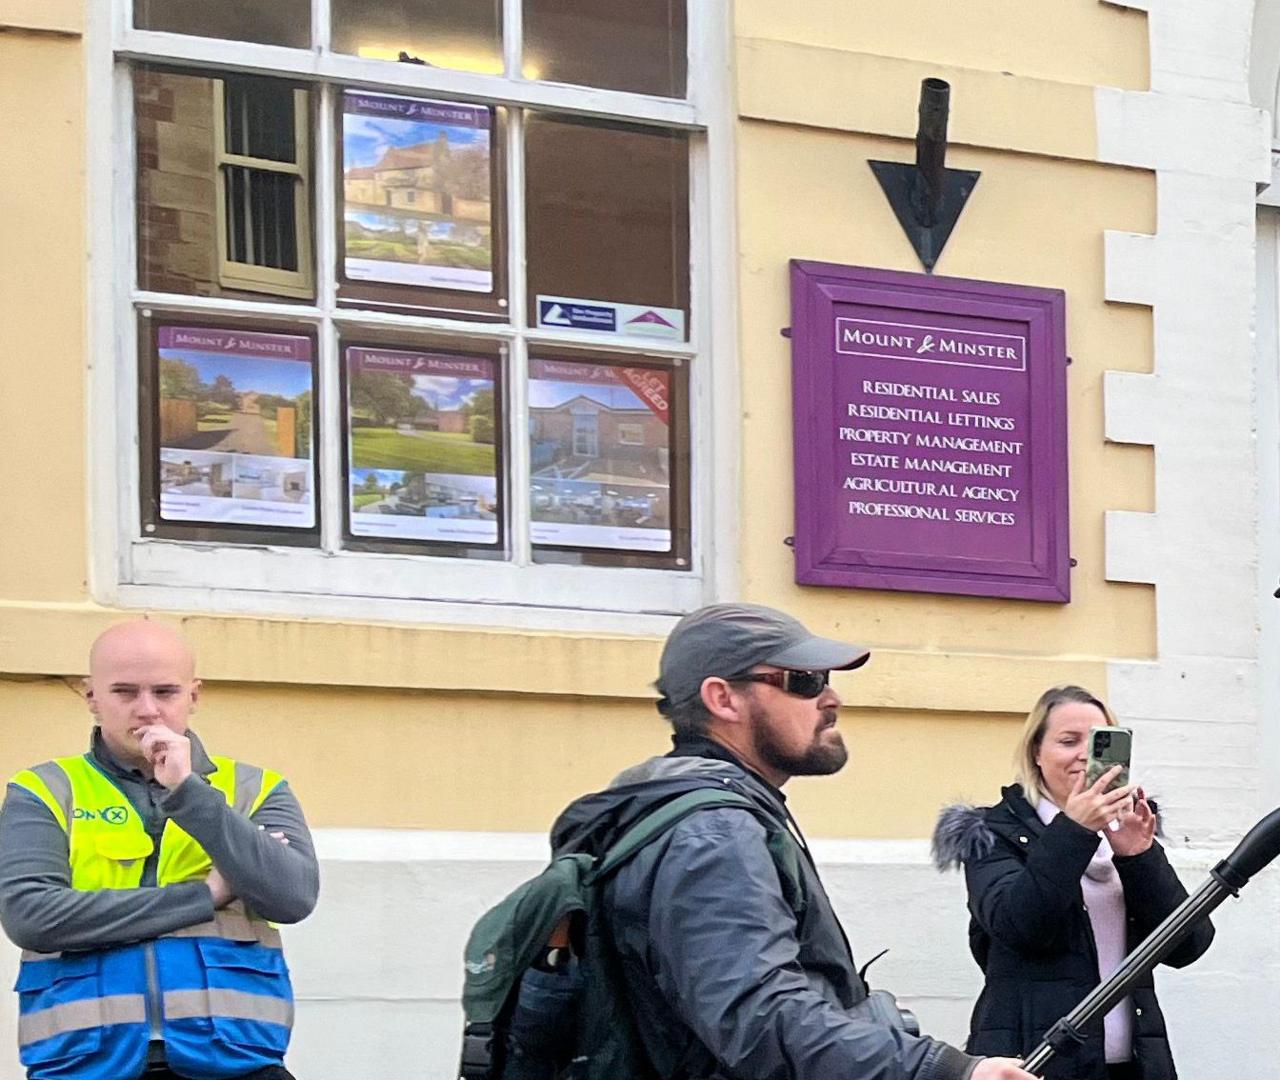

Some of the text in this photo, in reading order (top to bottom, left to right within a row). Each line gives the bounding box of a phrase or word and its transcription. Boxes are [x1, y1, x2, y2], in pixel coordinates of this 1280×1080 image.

[844, 329, 1018, 360] MOUNT & MINSTER
[623, 367, 669, 412] AGREED
[642, 370, 665, 392] LET
[863, 381, 1000, 405] RESIDENTIAL SALES
[848, 404, 1015, 430] RESIDENTIAL LETTINGS
[840, 428, 1024, 455] PROPERTY MANAGEMENT
[851, 453, 1012, 478] ESTATE MANAGEMENT
[843, 477, 1020, 502] AGRICULTURAL AGENCY
[849, 502, 1016, 526] PROFESSIONAL SERVICES
